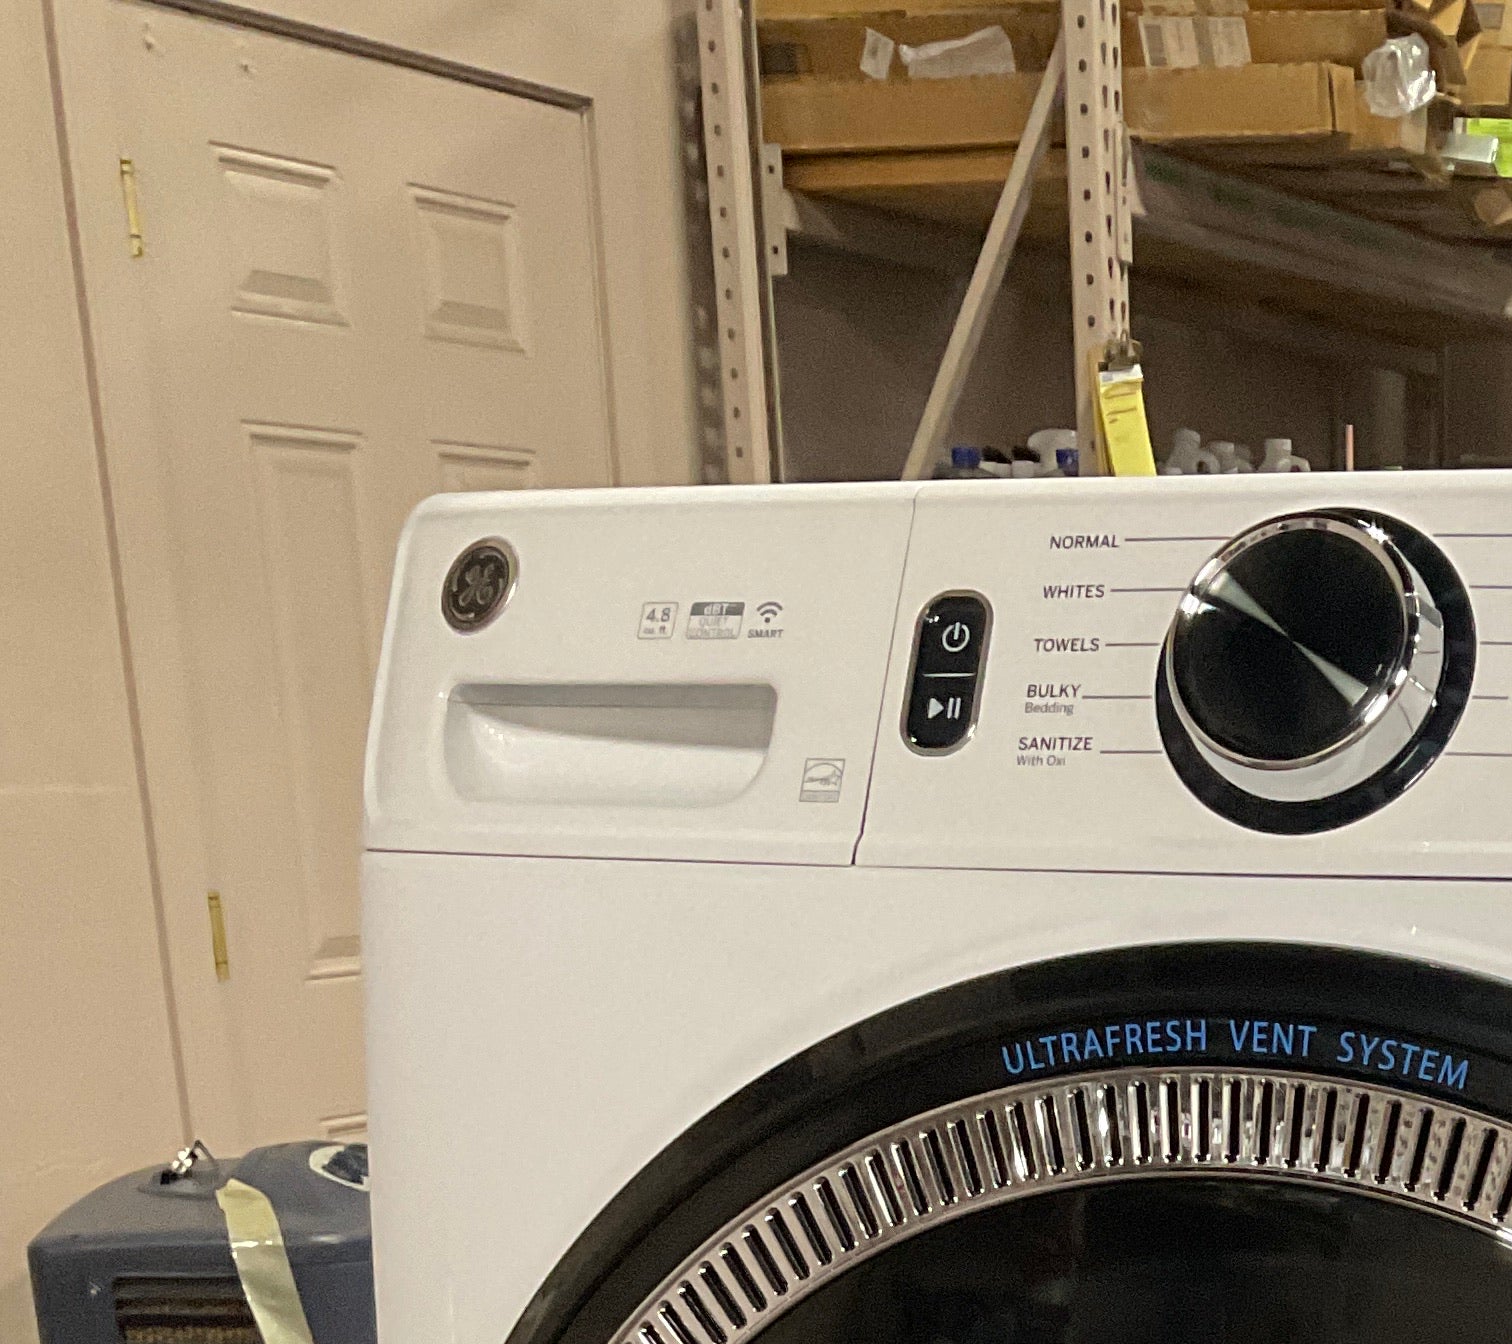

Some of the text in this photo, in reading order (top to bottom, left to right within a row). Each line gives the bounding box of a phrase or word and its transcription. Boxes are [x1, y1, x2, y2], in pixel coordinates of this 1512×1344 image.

[1050, 534, 1120, 549] NORMAL
[1043, 584, 1105, 599] WHITES
[645, 607, 671, 623] 4.8
[747, 629, 784, 639] SMART
[1034, 638, 1100, 653] TOWELS
[1027, 684, 1082, 699] BULKY
[1024, 701, 1074, 716] Bedding
[1018, 737, 1093, 751] SANITIZE
[1016, 755, 1043, 766] With
[1002, 1018, 1469, 1091] ULTRAFRESH VENT SYSTEM
